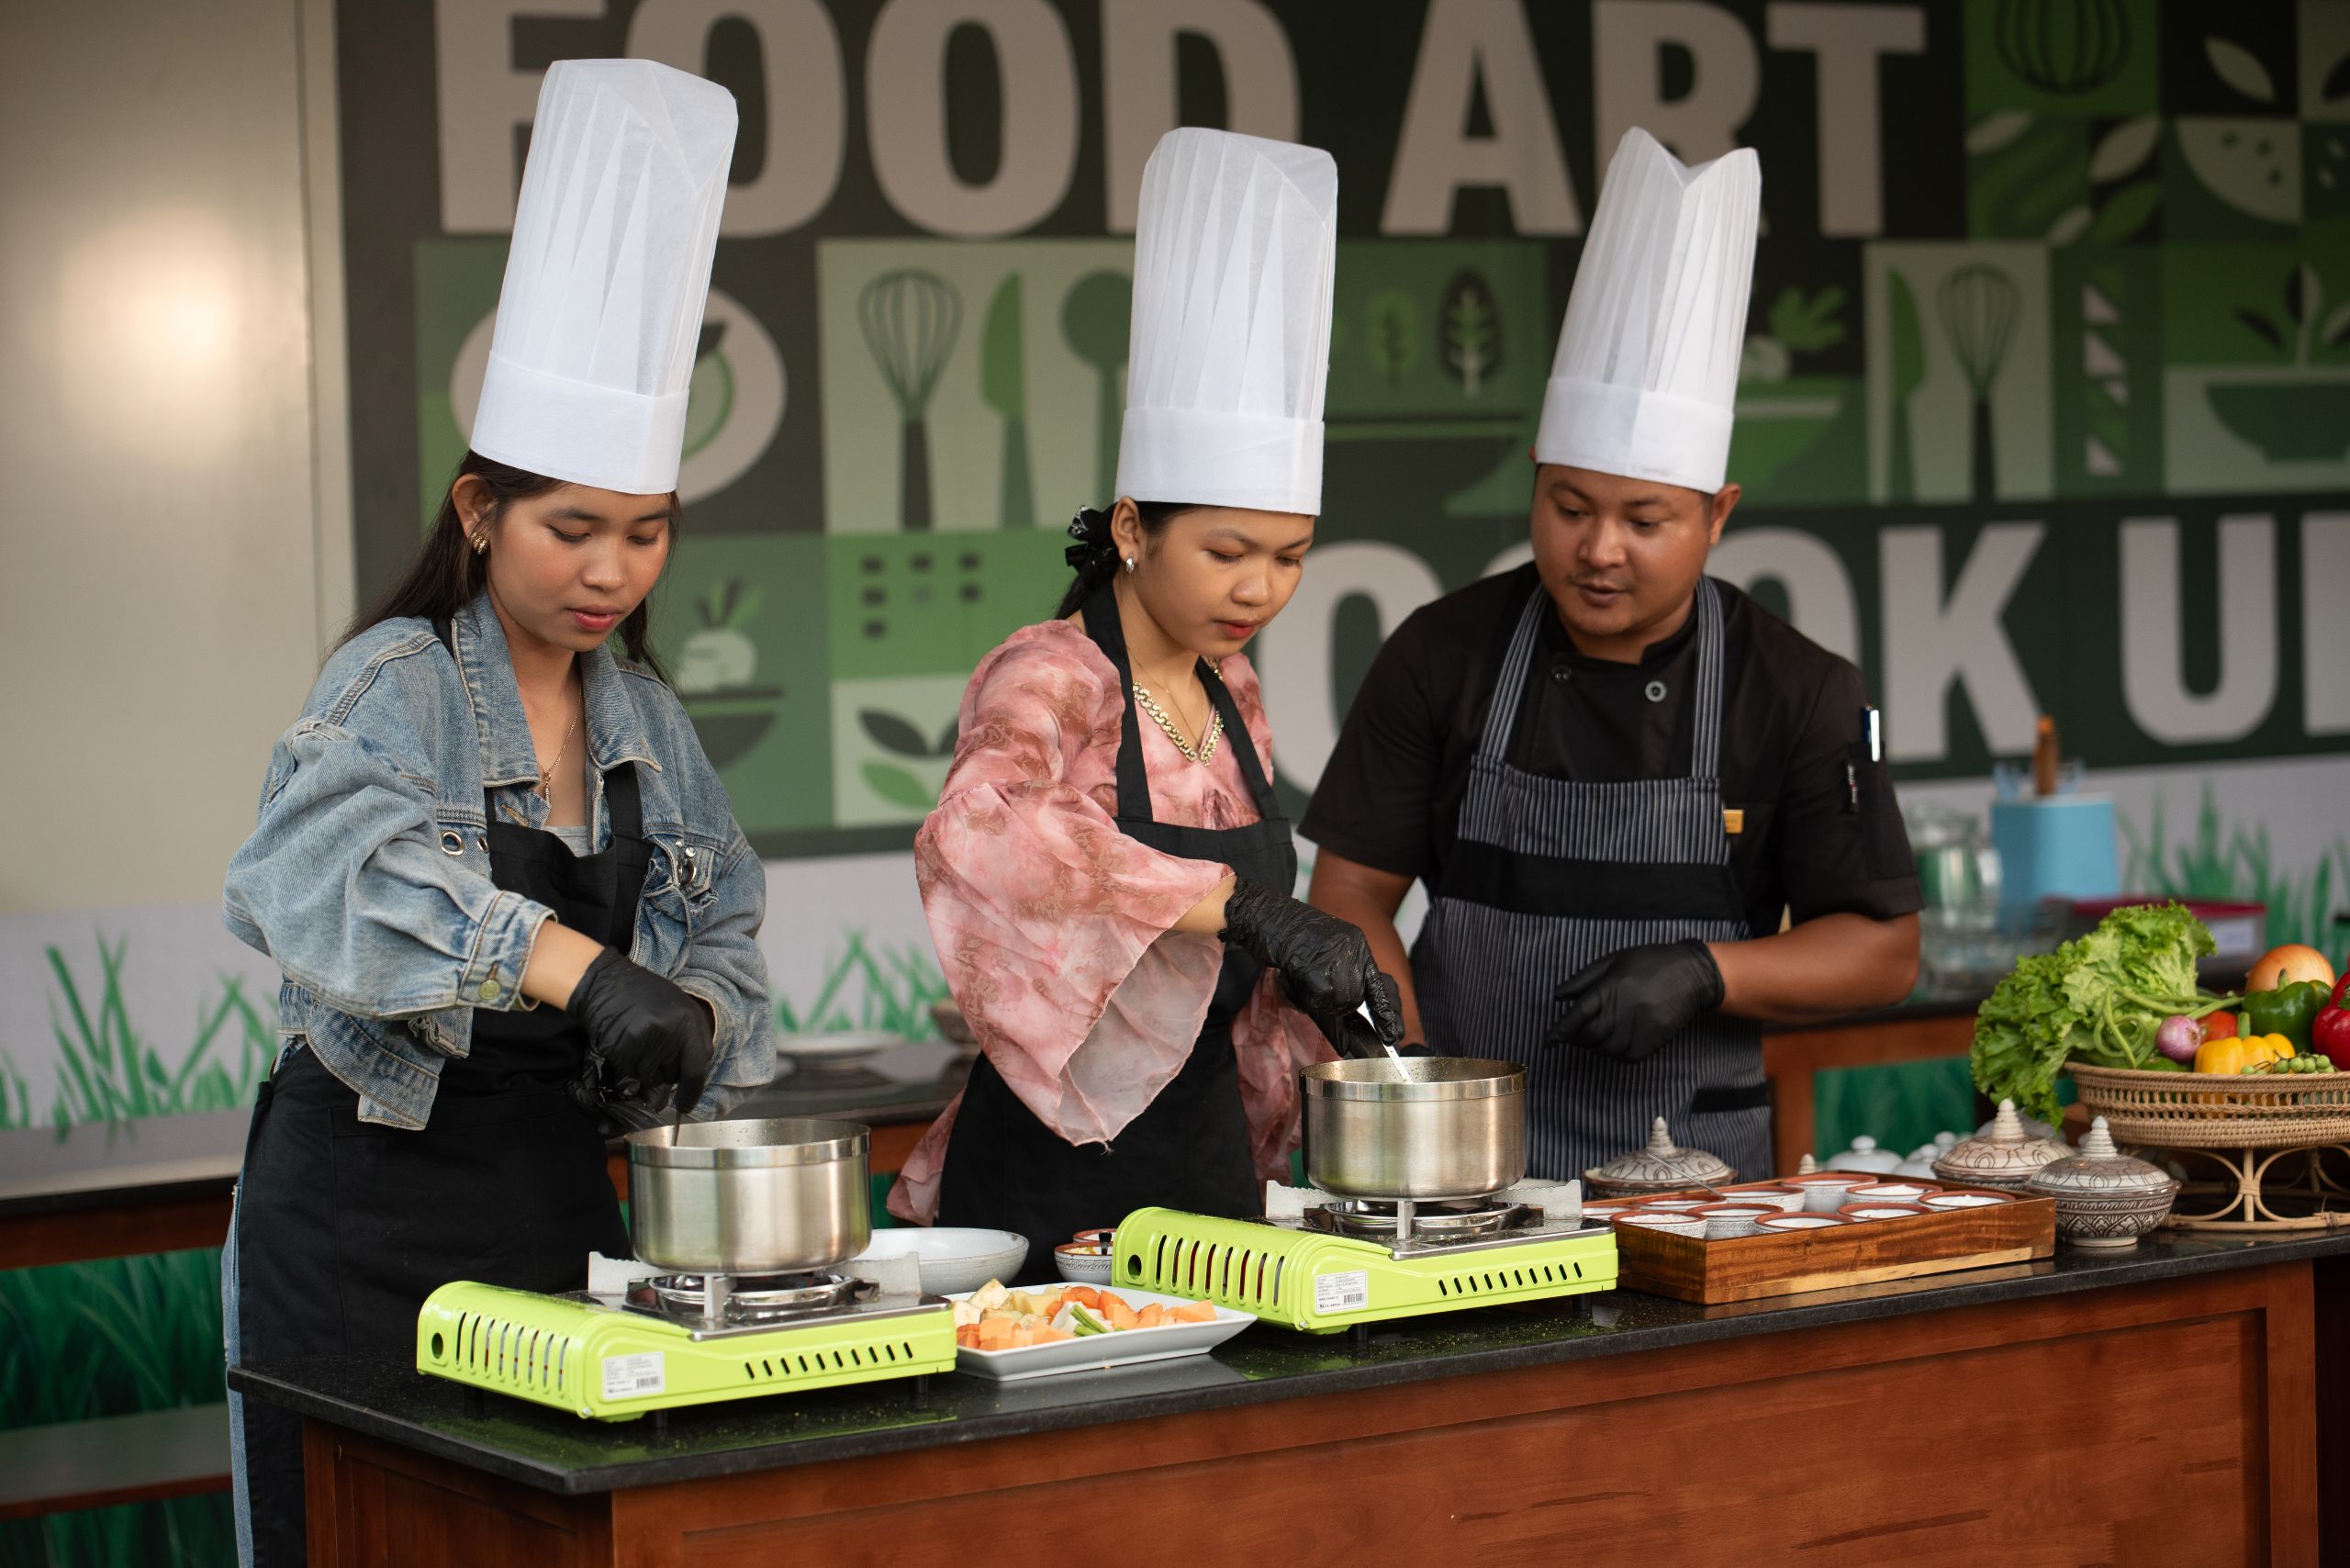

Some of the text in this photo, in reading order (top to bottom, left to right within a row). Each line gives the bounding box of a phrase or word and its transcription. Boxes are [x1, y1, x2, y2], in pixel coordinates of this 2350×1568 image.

[435, 0, 1926, 239] FOOD ART
[1259, 520, 2050, 795] CK
